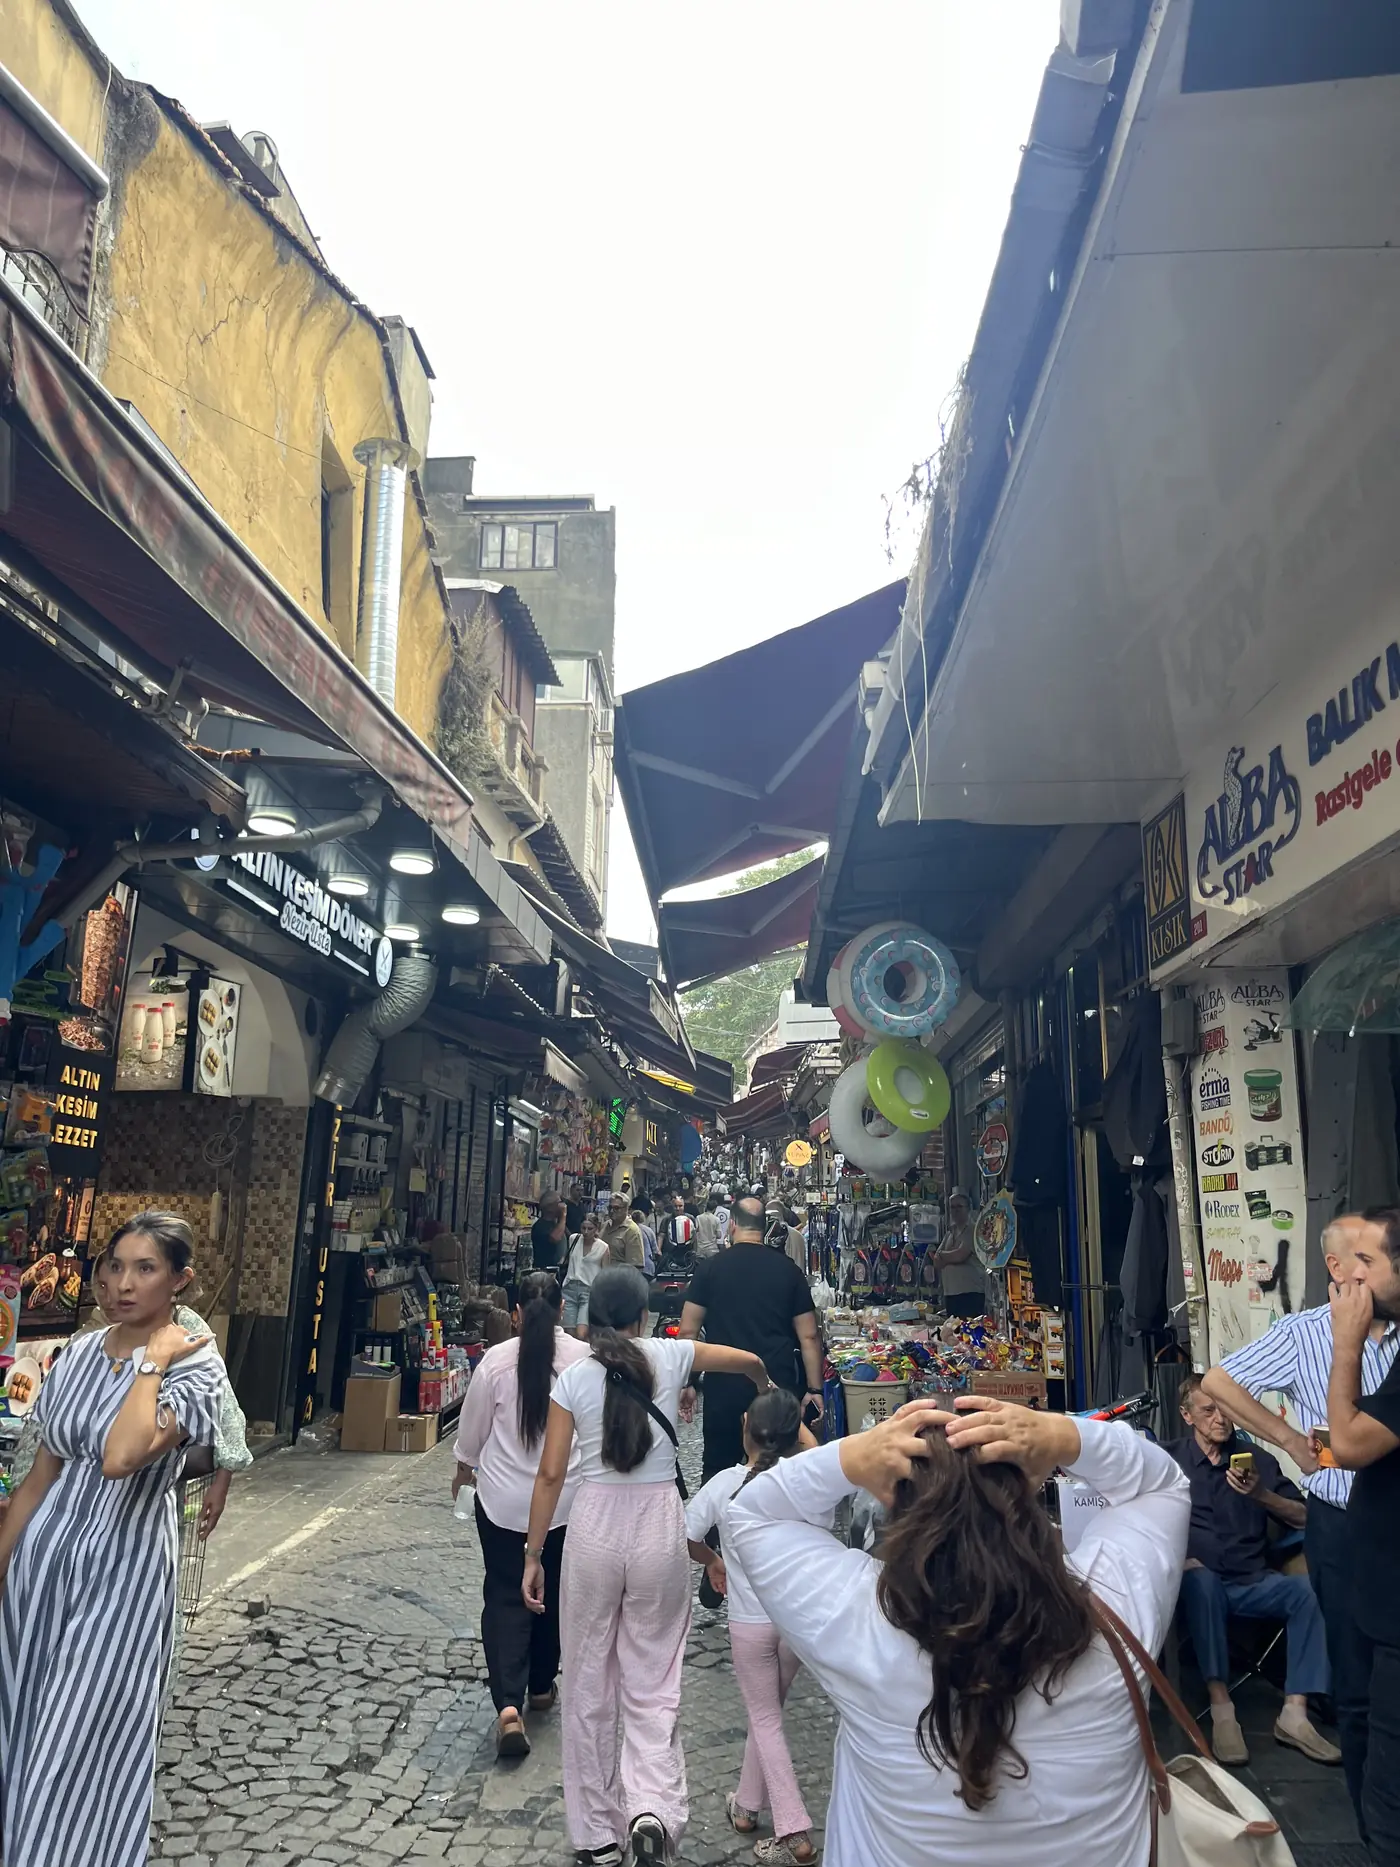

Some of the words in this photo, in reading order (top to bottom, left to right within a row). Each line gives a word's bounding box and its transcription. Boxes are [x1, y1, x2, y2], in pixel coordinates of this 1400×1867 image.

[1306, 656, 1386, 766] BALIK
[1316, 748, 1392, 827] Rastgele
[1223, 841, 1275, 905] STAR
[309, 919, 331, 956] Usta
[331, 902, 375, 957] DÖNER
[1232, 984, 1284, 1001] ALBA
[1246, 999, 1271, 1007] STAR
[1203, 1011, 1218, 1024] STAR
[60, 1065, 100, 1091] ALTIN
[1199, 1076, 1231, 1099] erma
[55, 1093, 98, 1119] KESİM
[1219, 1094, 1231, 1107] TIME
[1203, 1146, 1232, 1165] STORM
[1207, 1247, 1244, 1288] Mepps
[307, 1247, 328, 1374] USTA
[1074, 1496, 1104, 1510] KAMIŞ
